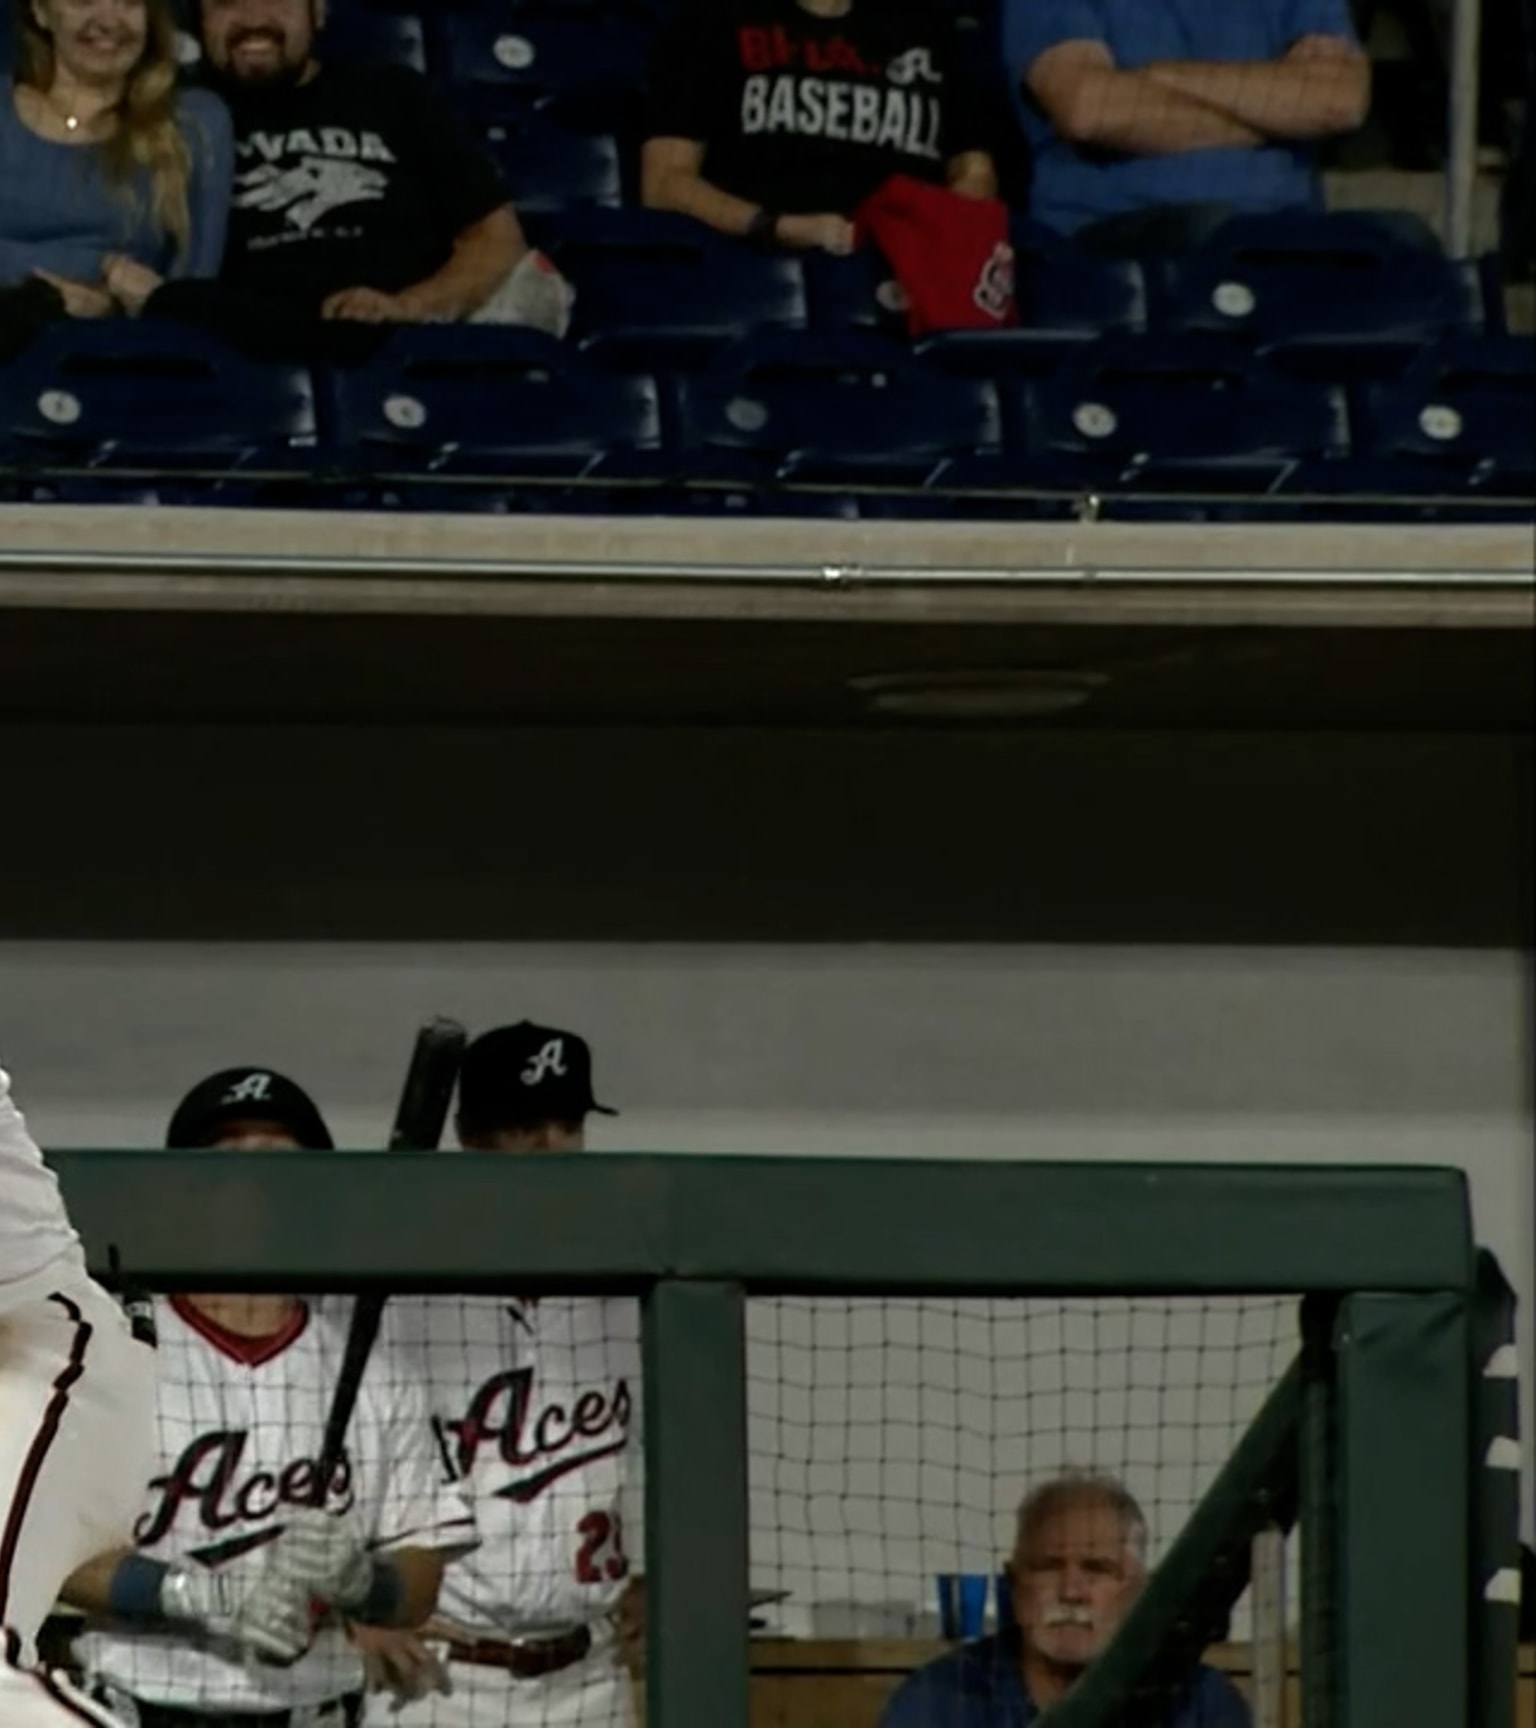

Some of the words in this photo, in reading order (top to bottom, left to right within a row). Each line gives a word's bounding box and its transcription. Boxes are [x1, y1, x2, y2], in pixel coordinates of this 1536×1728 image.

[741, 74, 942, 161] BASEBALL
[520, 1038, 568, 1086] A
[442, 1365, 632, 1478] Aces
